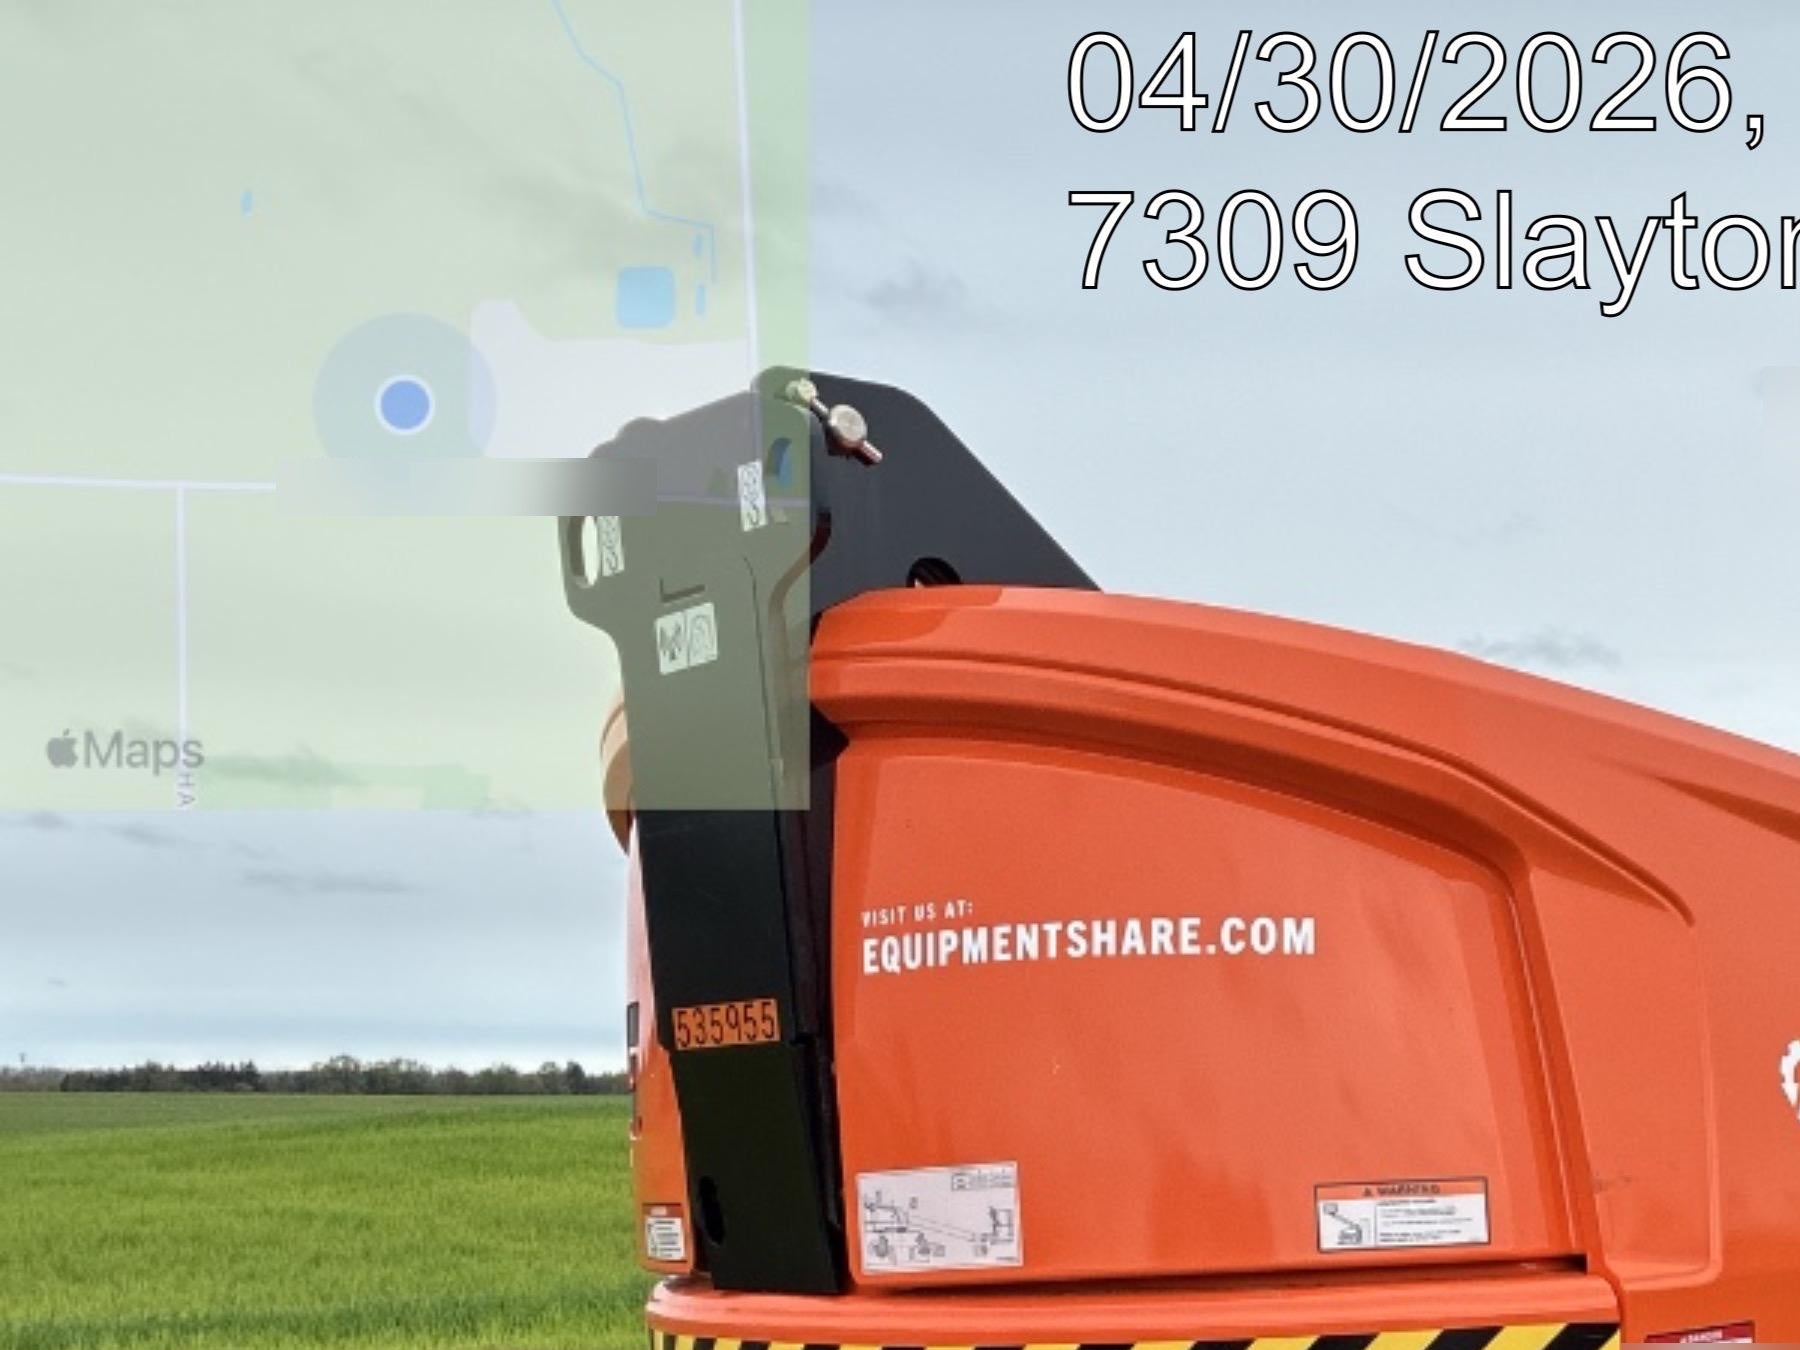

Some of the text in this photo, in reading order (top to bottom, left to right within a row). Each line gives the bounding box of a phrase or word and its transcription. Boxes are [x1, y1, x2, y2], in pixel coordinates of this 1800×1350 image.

[861, 899, 975, 929] VISIT US AT:
[862, 916, 1317, 975] EQUIPMENTSHARE.COM
[675, 1000, 776, 1049] 535955
